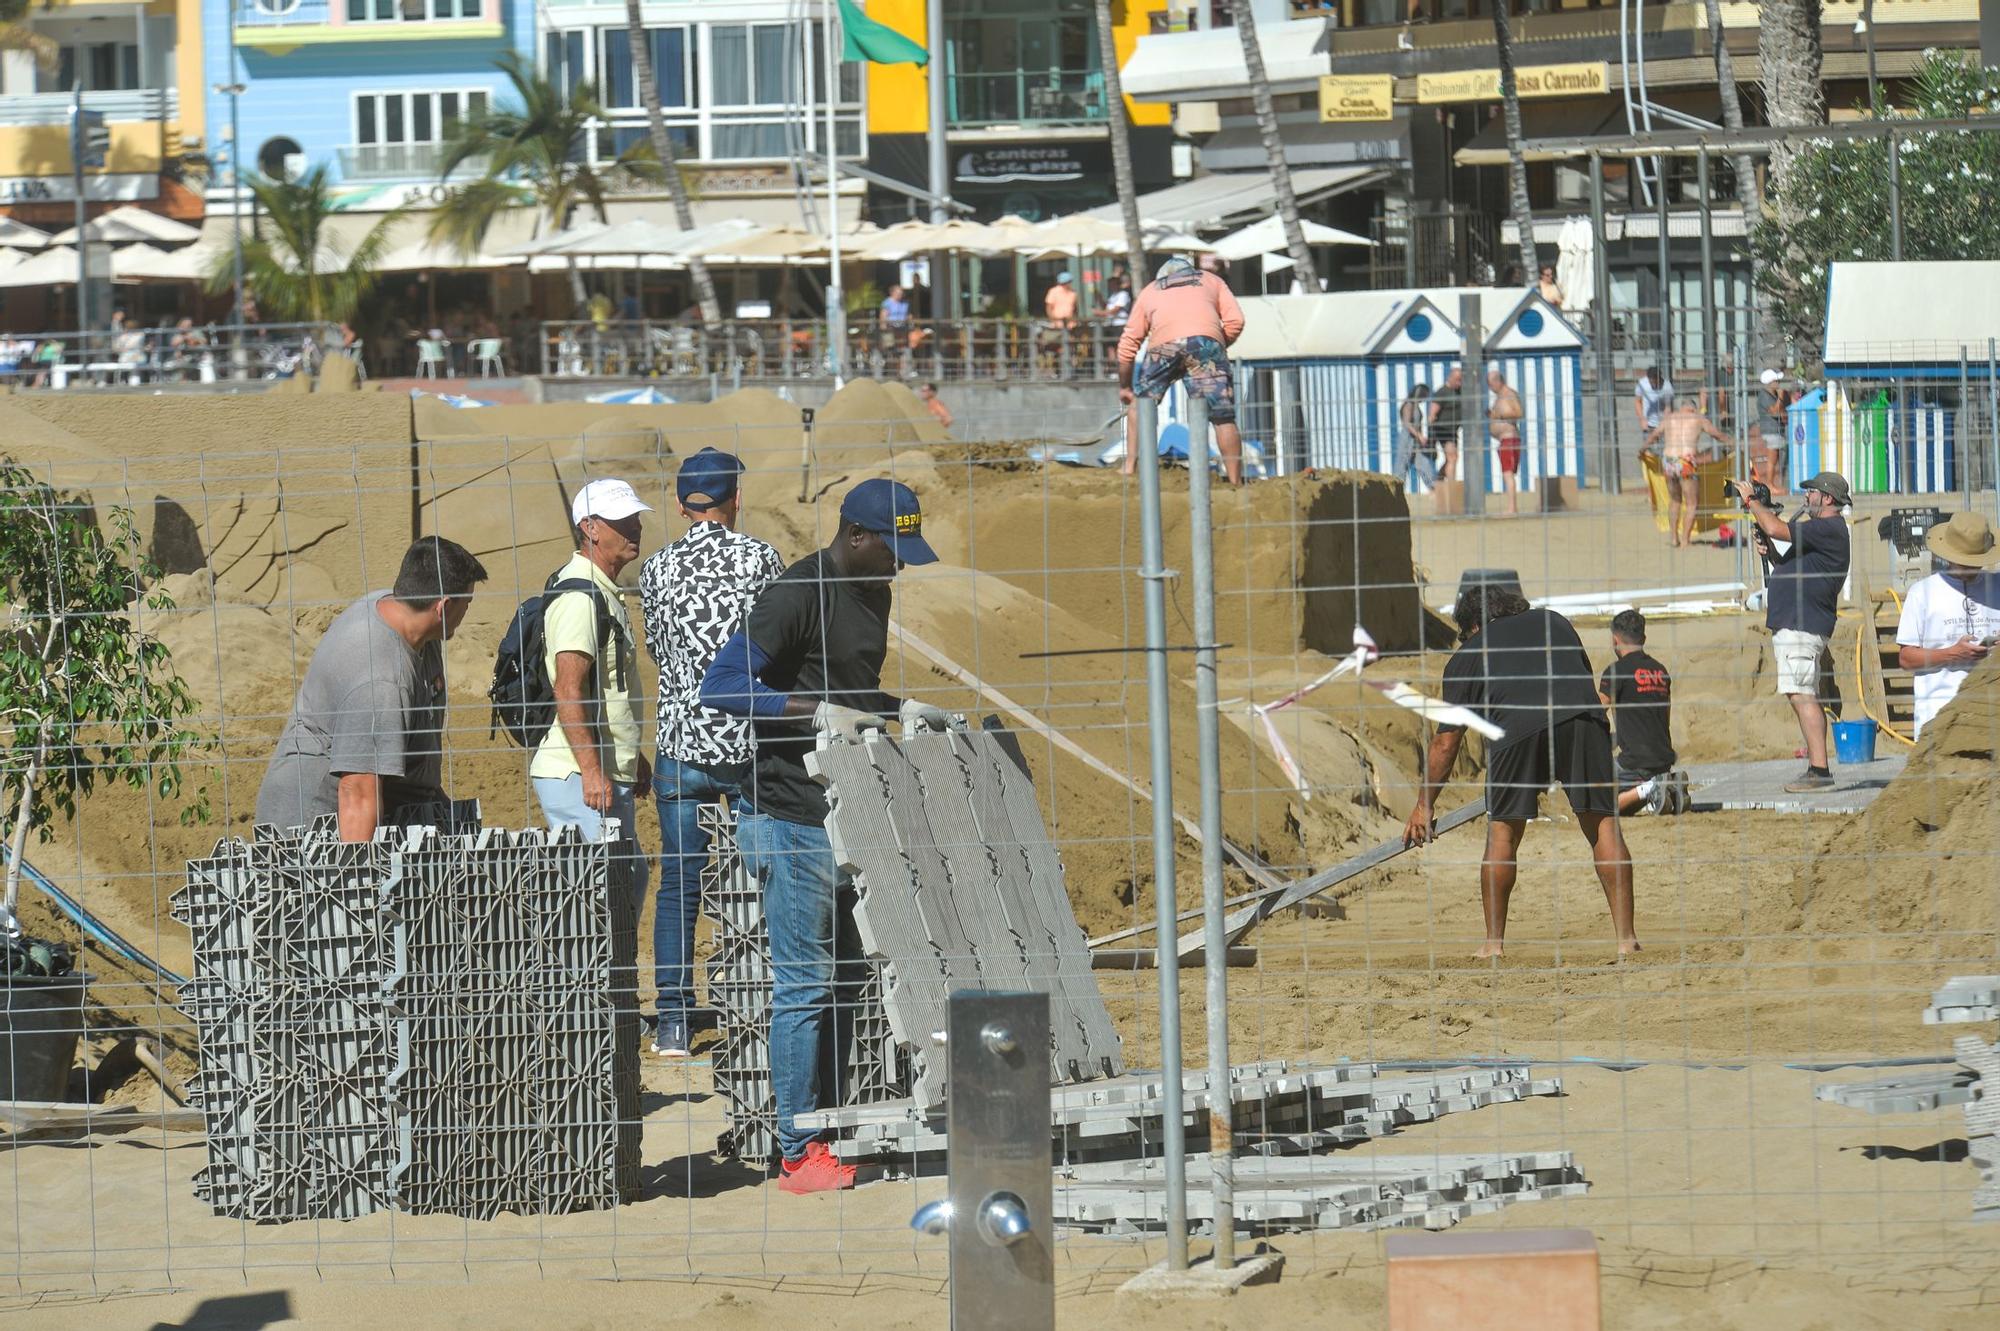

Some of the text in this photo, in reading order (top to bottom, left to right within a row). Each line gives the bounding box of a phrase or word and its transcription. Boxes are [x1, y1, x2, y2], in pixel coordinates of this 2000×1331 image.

[1515, 76, 1540, 91] asa
[1543, 69, 1601, 90] Carmelo
[1340, 97, 1375, 107] Casa
[1327, 107, 1388, 118] Carmelo
[984, 149, 1069, 160] canteras
[1029, 161, 1081, 174] playa
